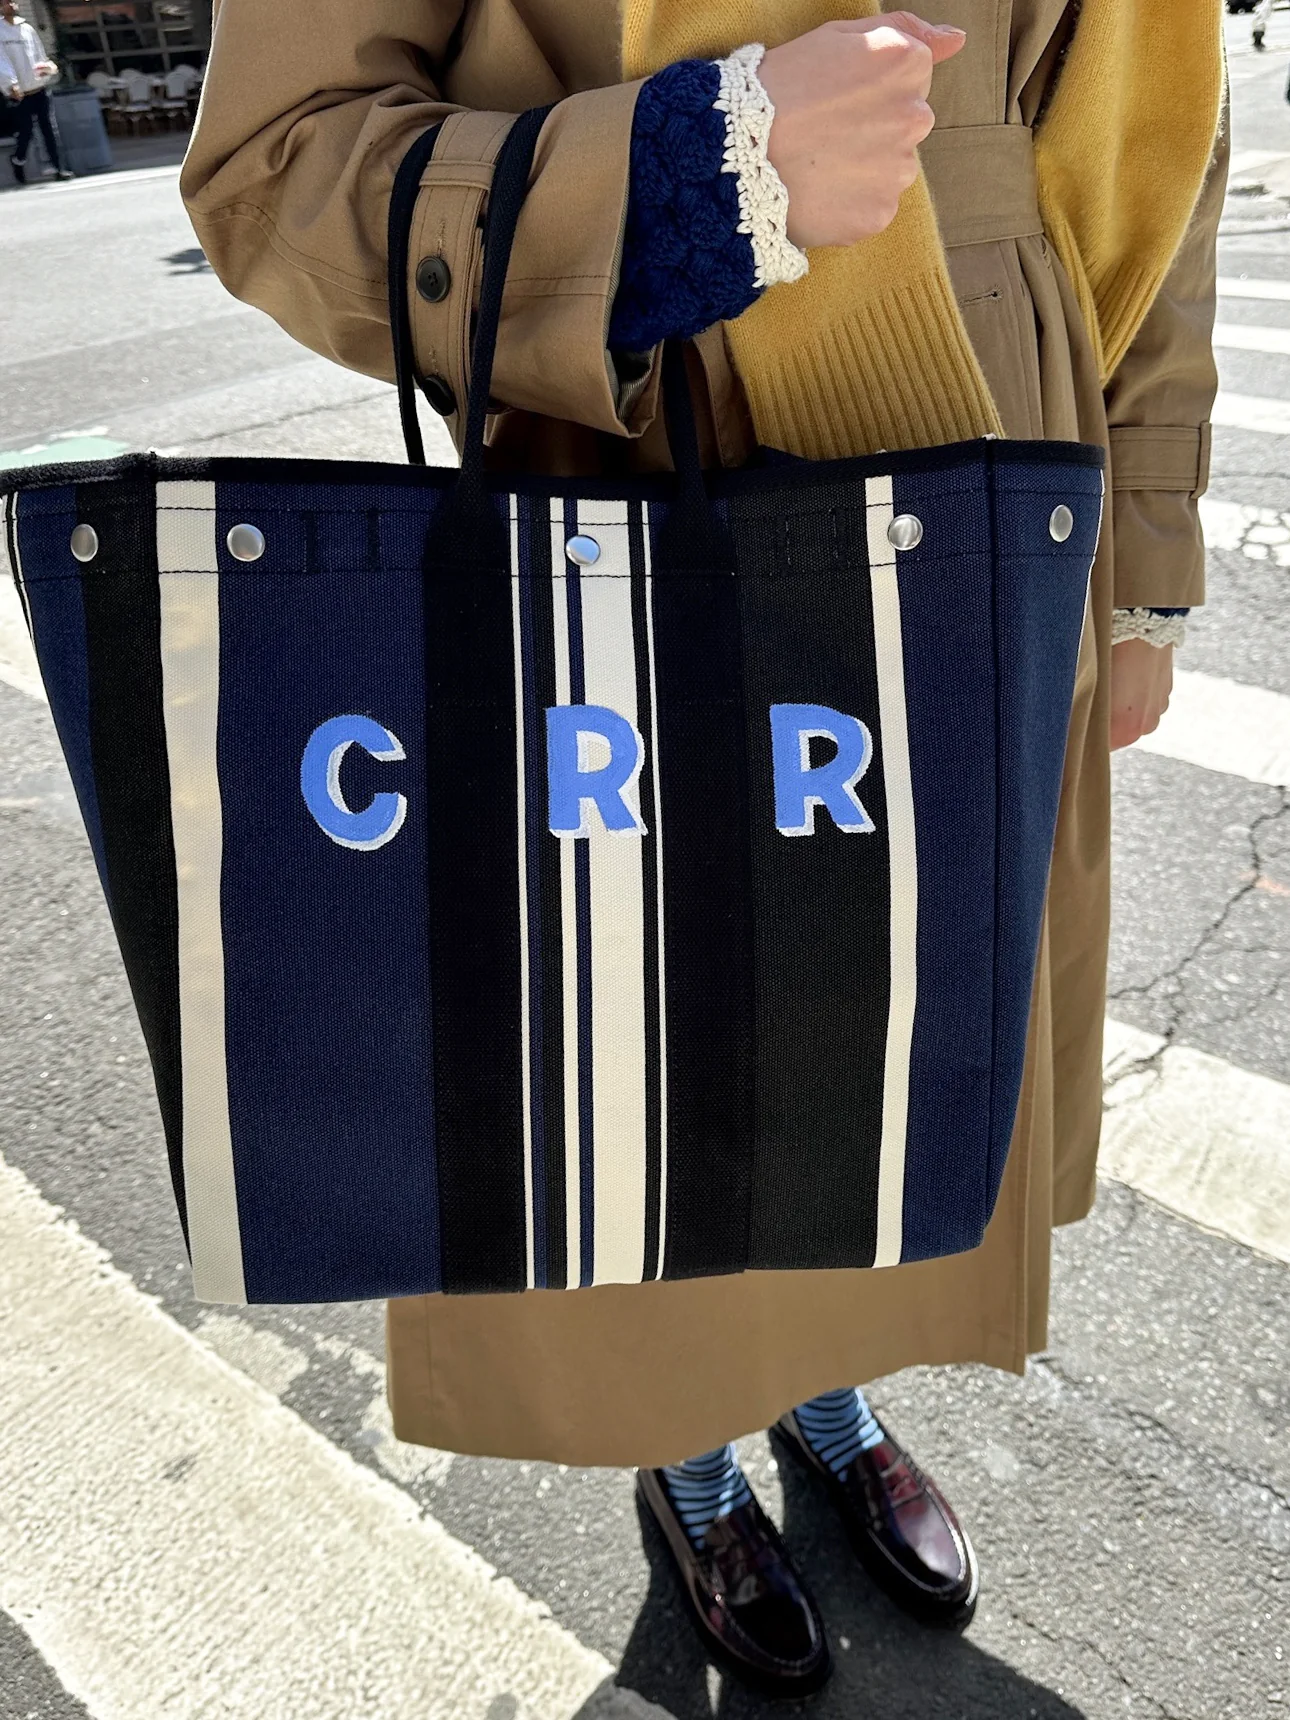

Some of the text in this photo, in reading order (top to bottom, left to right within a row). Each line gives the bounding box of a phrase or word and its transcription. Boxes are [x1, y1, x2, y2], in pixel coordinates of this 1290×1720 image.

[301, 703, 876, 851] C R R
